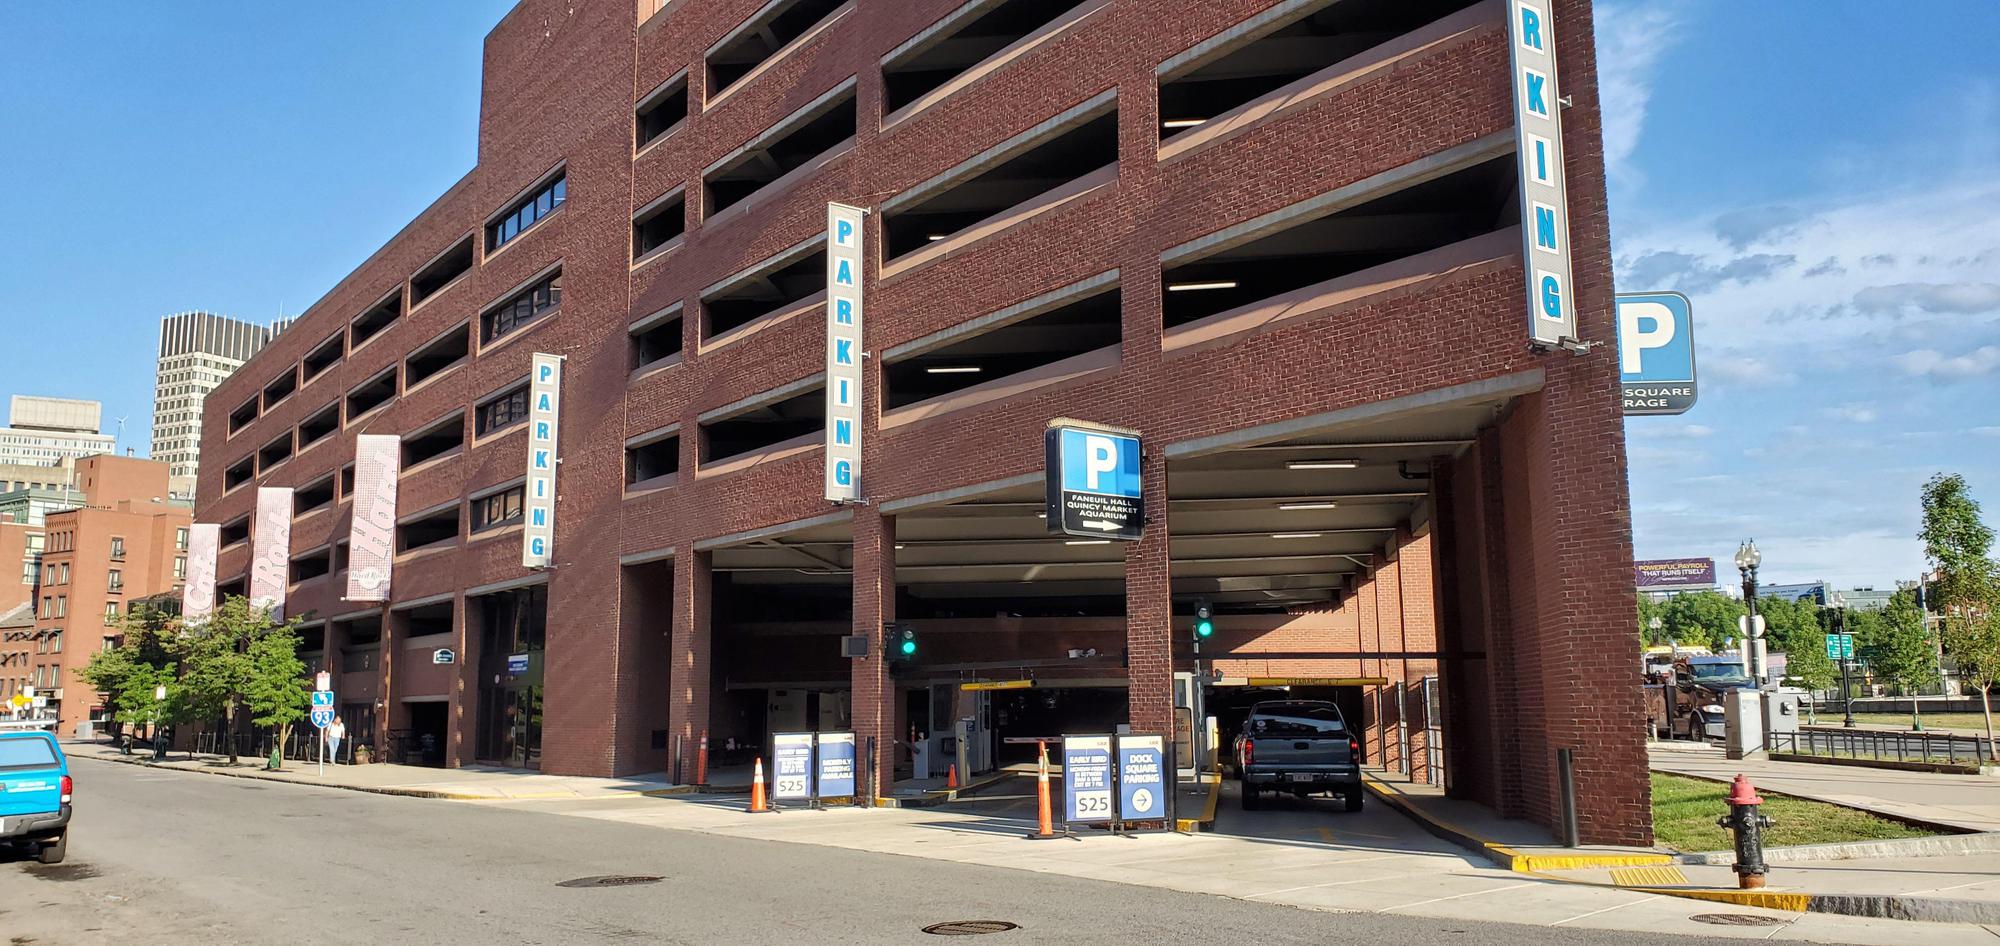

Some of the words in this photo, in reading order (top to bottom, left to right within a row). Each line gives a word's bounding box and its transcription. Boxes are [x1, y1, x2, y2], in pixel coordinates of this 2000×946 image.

[1521, 7, 1562, 319] RKING
[1619, 302, 1675, 374] P
[835, 219, 853, 486] PARKING
[1625, 387, 1691, 398] SQUARE
[1624, 399, 1668, 408] RAGE
[532, 365, 552, 556] PARKING
[1086, 434, 1117, 490] P
[1072, 494, 1109, 505] FANEUIL
[1110, 498, 1132, 507] HALL
[1067, 501, 1101, 511] QUINCY
[1103, 504, 1138, 514] MARKET
[1079, 510, 1127, 520] AQUARIUM
[314, 711, 330, 725] 93
[1069, 756, 1090, 764] EARLY
[1129, 754, 1153, 763] DOCK
[1125, 763, 1158, 774] SQUARE
[1123, 774, 1160, 784] PARKING
